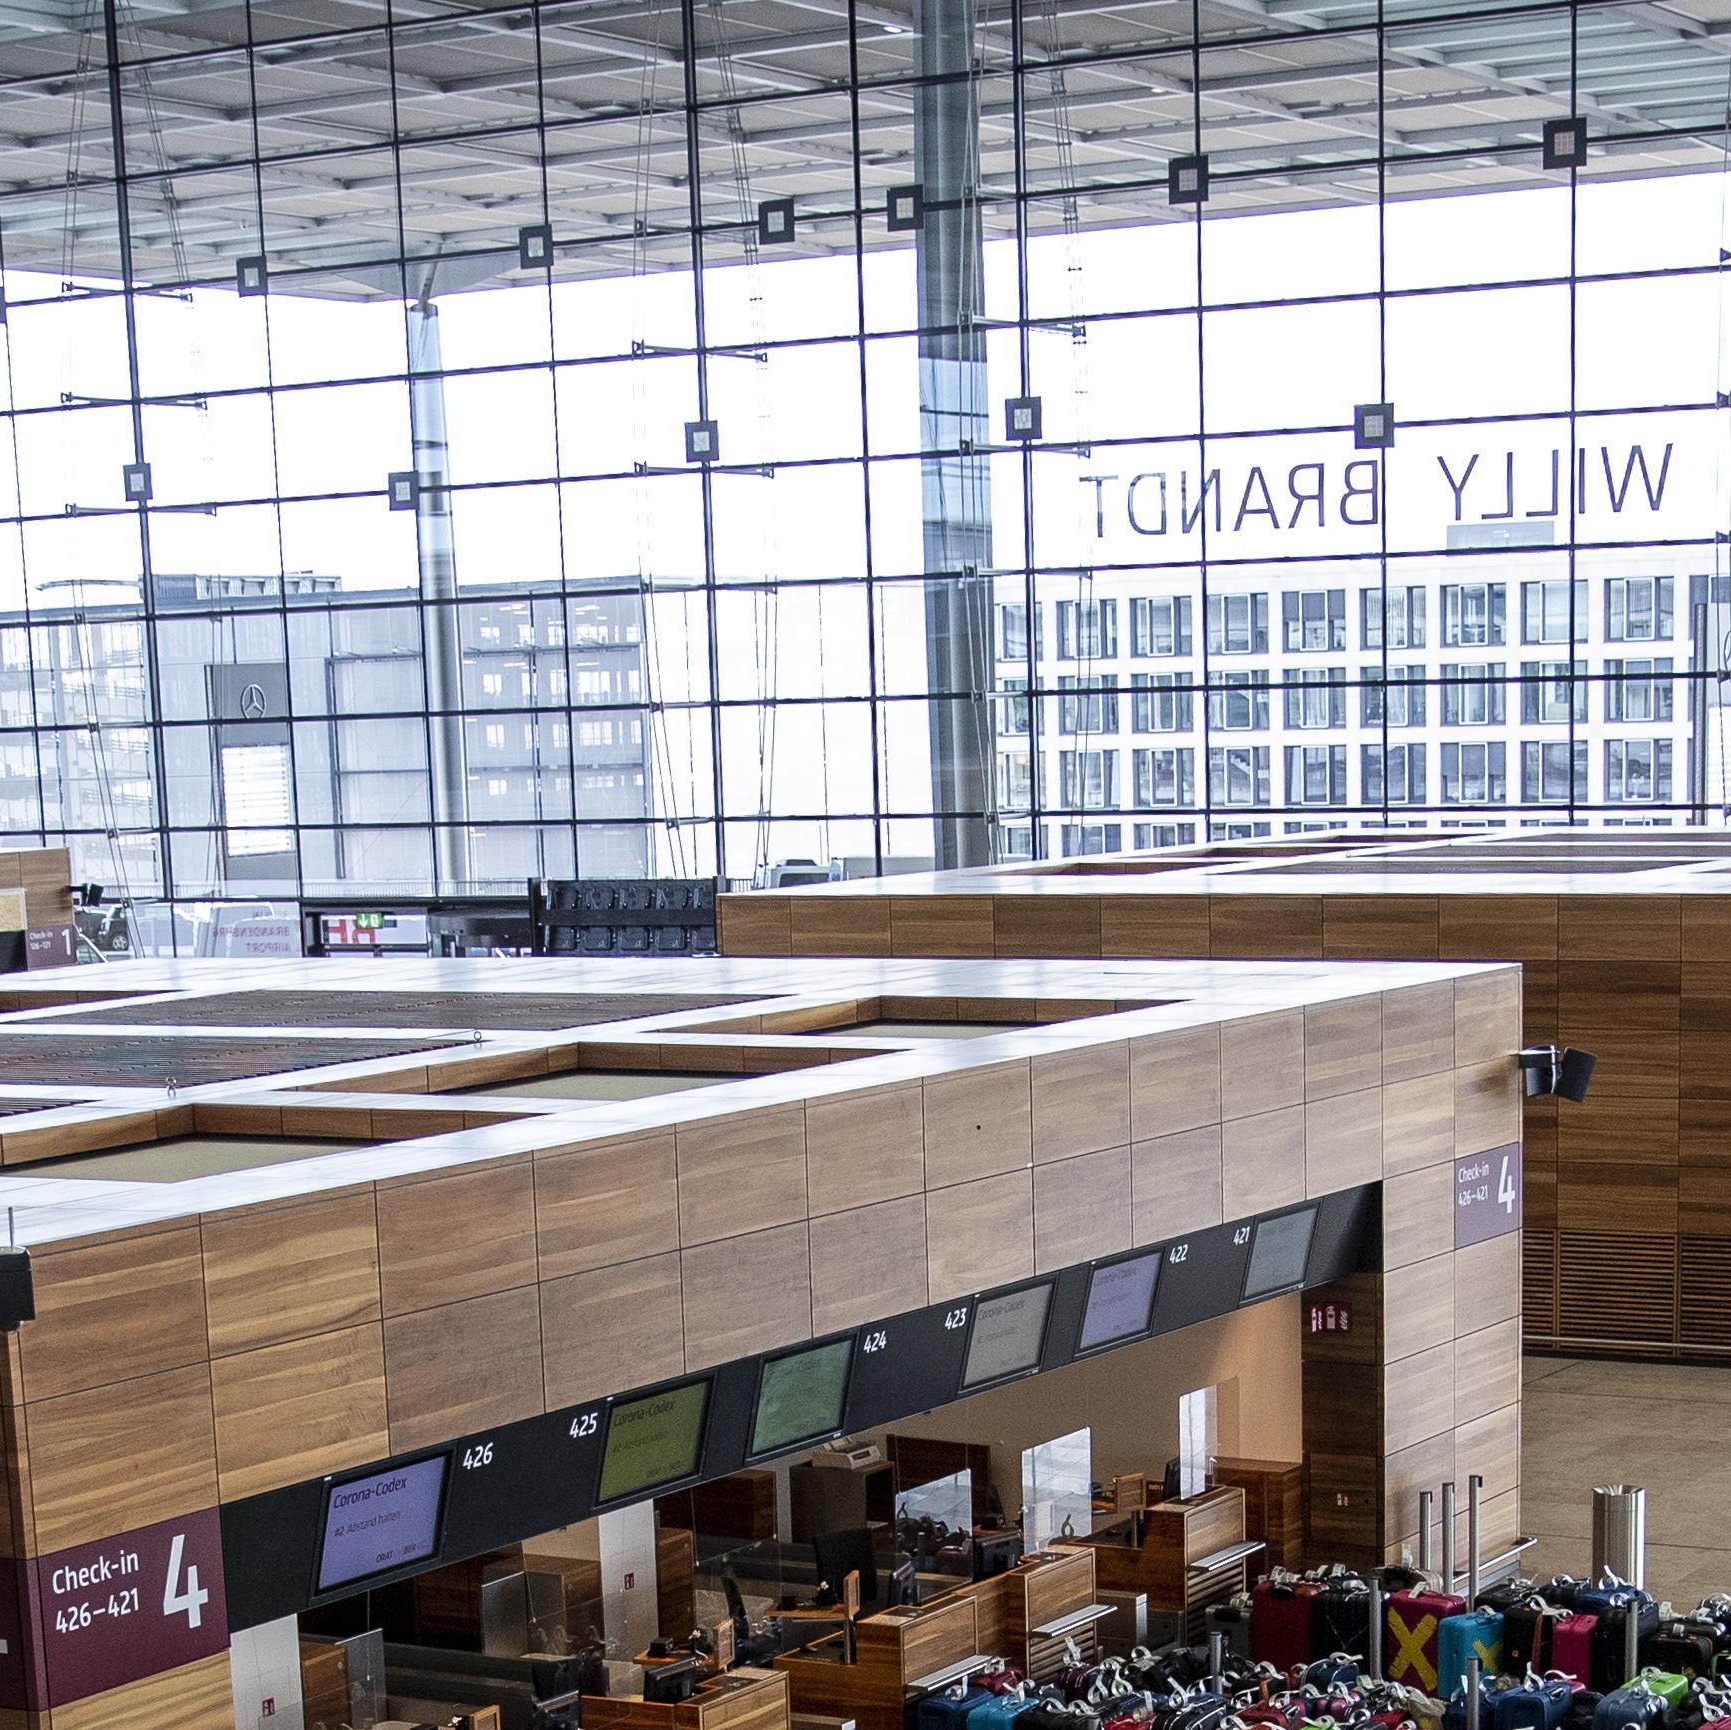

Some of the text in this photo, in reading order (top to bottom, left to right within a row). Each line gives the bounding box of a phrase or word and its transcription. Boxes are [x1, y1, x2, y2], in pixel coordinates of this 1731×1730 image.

[29, 930, 54, 940] Check-in
[61, 928, 72, 956] 1
[1458, 1161, 1490, 1184] Check-in
[1497, 1155, 1516, 1215] 4
[1232, 1225, 1251, 1246] 421
[1169, 1243, 1189, 1265] 422
[944, 1306, 968, 1331] 423
[863, 1330, 887, 1354] 424
[569, 1412, 599, 1439] 425
[613, 1400, 675, 1427] Corona-Codex
[462, 1442, 494, 1471] 426
[333, 1476, 408, 1509] Corona-Codex
[52, 1549, 140, 1596] Check-in
[162, 1533, 210, 1629] 4
